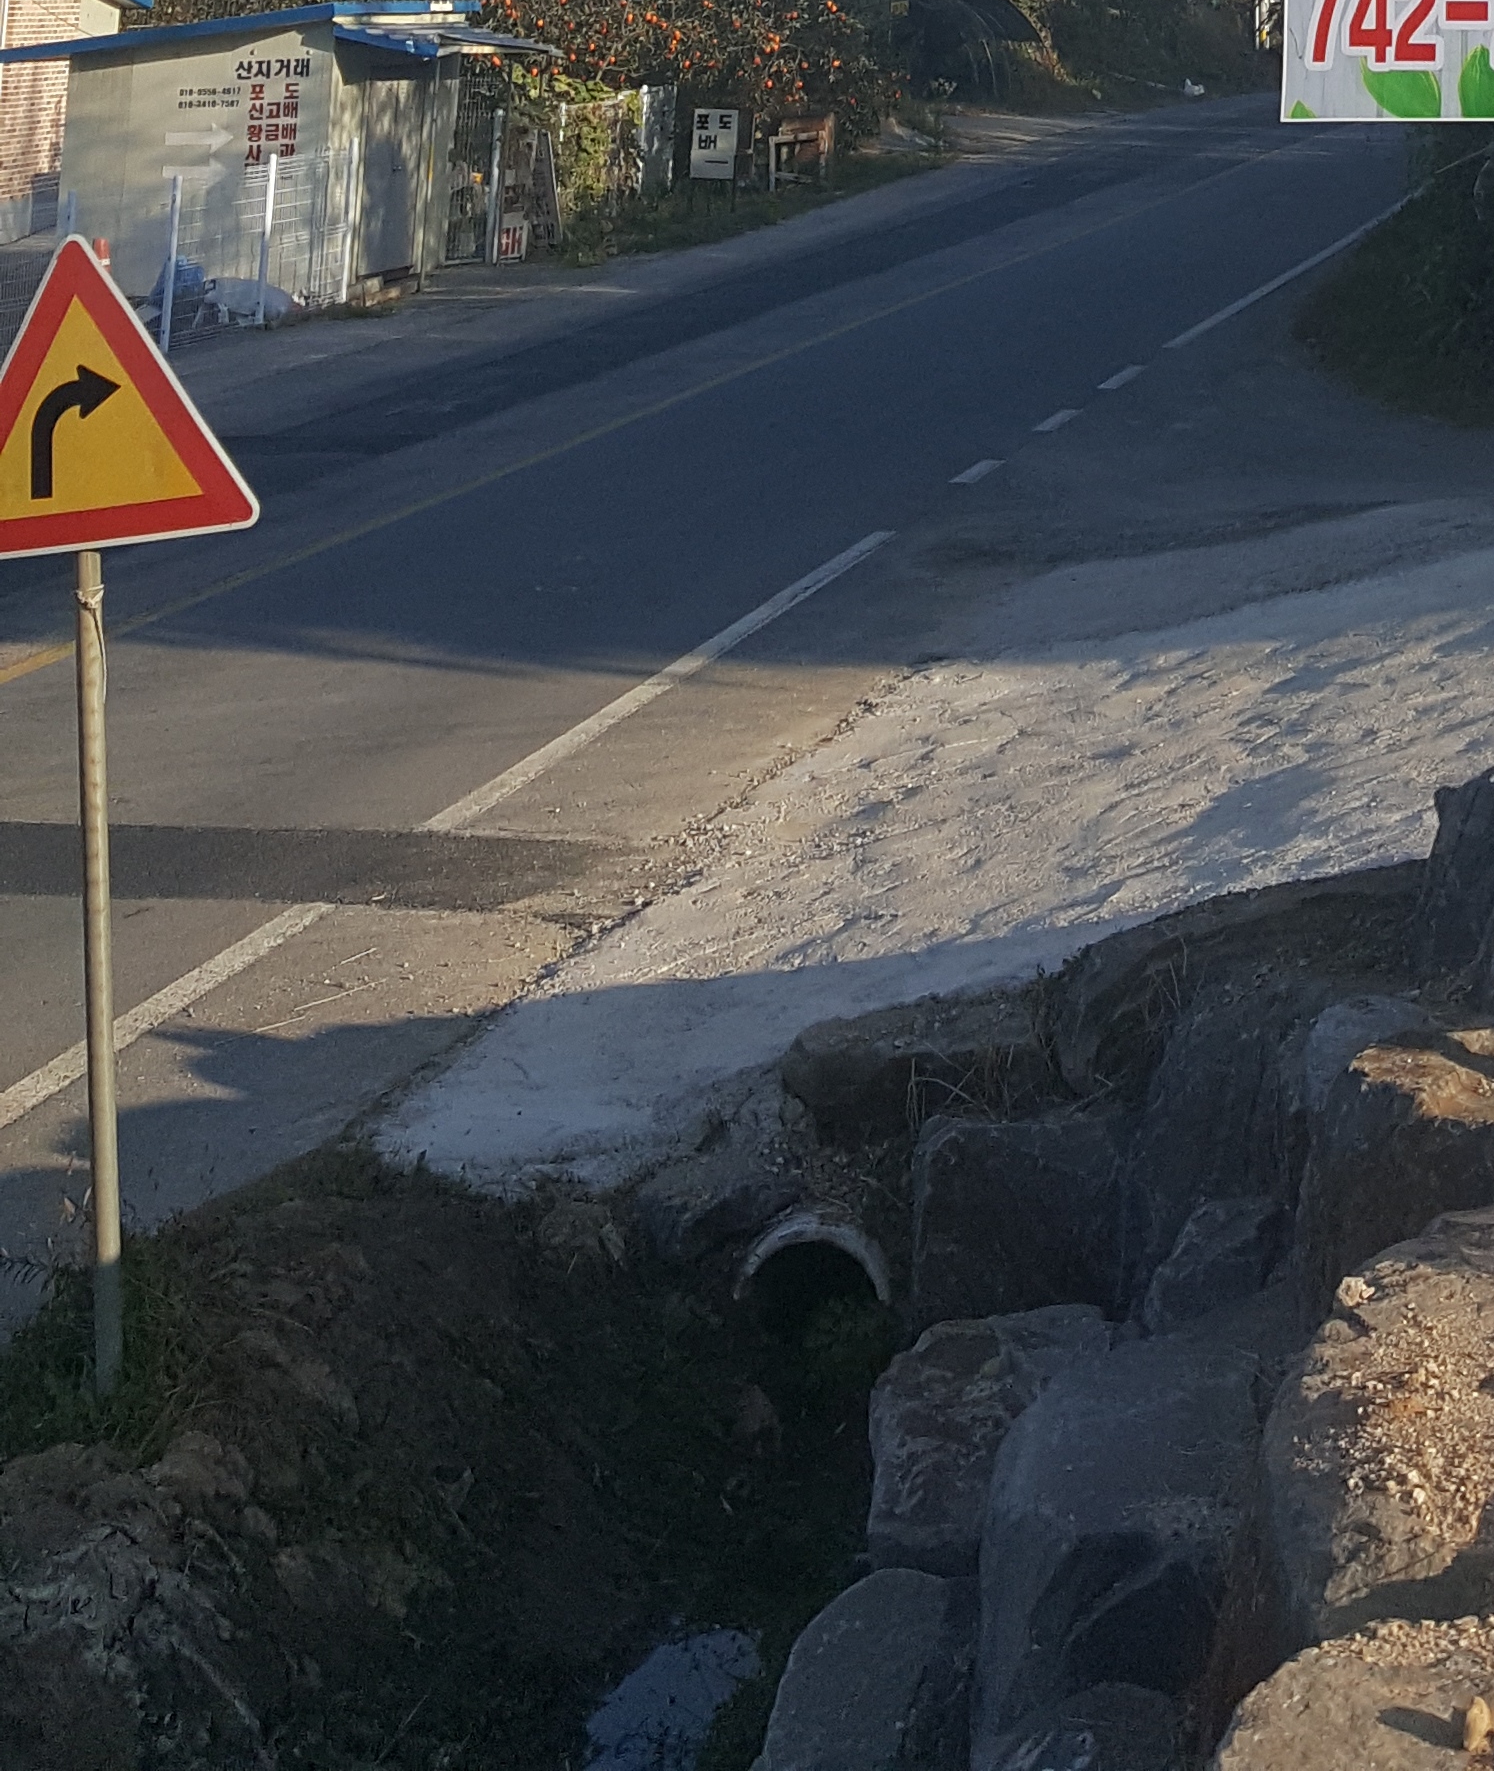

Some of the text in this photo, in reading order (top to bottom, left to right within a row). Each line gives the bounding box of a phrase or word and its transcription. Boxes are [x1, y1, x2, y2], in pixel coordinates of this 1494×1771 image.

[235, 58, 311, 80] 산지거래
[248, 102, 299, 121] 신고배
[247, 123, 297, 142] 황금배
